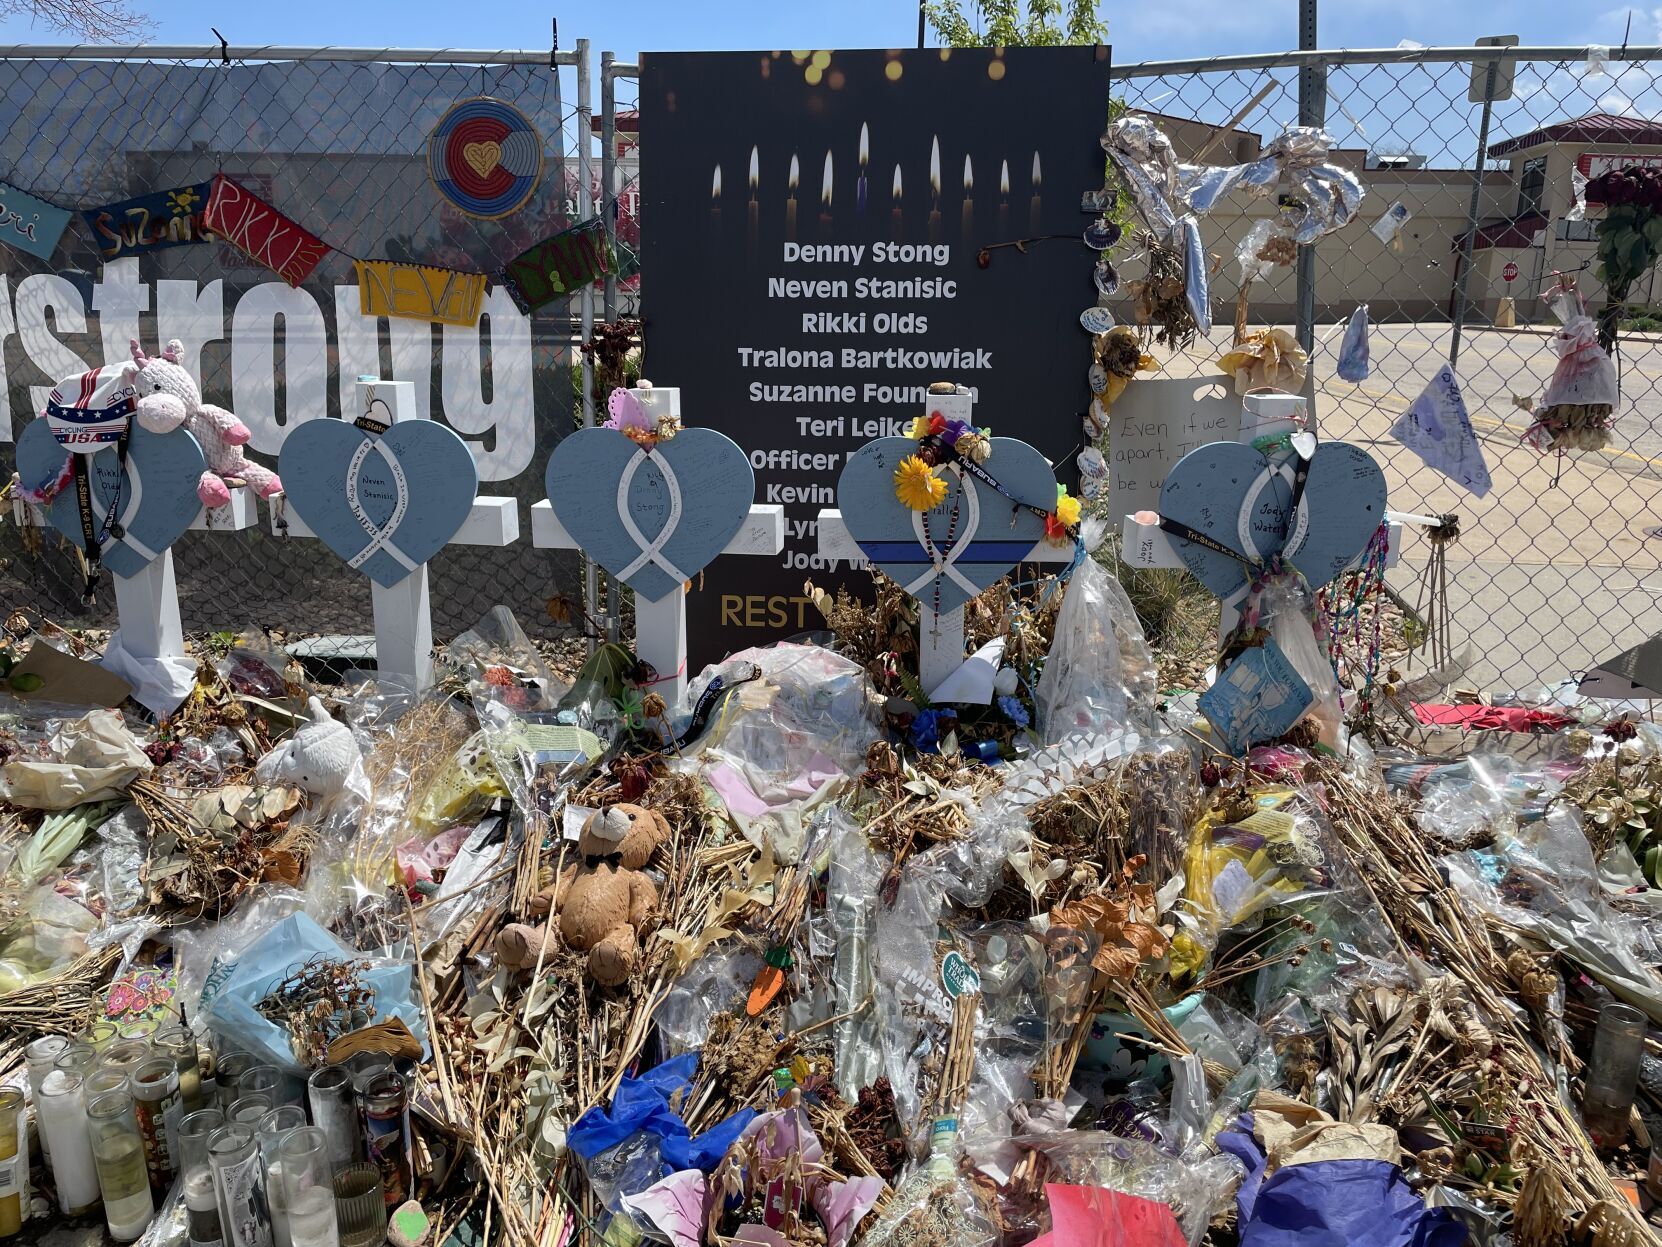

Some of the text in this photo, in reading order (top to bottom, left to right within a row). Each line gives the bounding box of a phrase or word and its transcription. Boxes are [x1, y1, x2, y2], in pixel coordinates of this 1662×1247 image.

[208, 180, 303, 274] RIKKI
[783, 241, 950, 266] Denny Stong
[768, 276, 957, 299] Neven Stanisic
[802, 312, 928, 334] Rikki Olds
[737, 347, 993, 369] Tralona Bartkowiak
[0, 257, 536, 482] strong
[749, 382, 979, 404] Suzanne Founn
[59, 426, 88, 434] CYCLING
[356, 418, 386, 433] Tri-State
[796, 417, 917, 438] Teri Leike
[1120, 416, 1168, 438] Even
[1183, 413, 1197, 434] if
[1203, 417, 1229, 431] we
[64, 433, 102, 444] USA
[750, 449, 840, 471] Officer
[1115, 442, 1169, 464] apart,
[362, 474, 385, 486] Neven
[957, 455, 997, 489] SUBARU
[1117, 472, 1137, 491] be
[766, 483, 834, 504] Kevin
[77, 474, 93, 541] Tri-State K-9 CRT
[636, 502, 665, 516] Stong
[1260, 503, 1287, 521] Jody
[783, 517, 818, 540] Lyn
[1253, 521, 1284, 534] Water
[1186, 529, 1221, 551] Tri-State
[782, 550, 839, 574] Jody
[721, 595, 810, 628] REST
[947, 965, 966, 988] TRAD
[950, 957, 969, 982] WHOL
